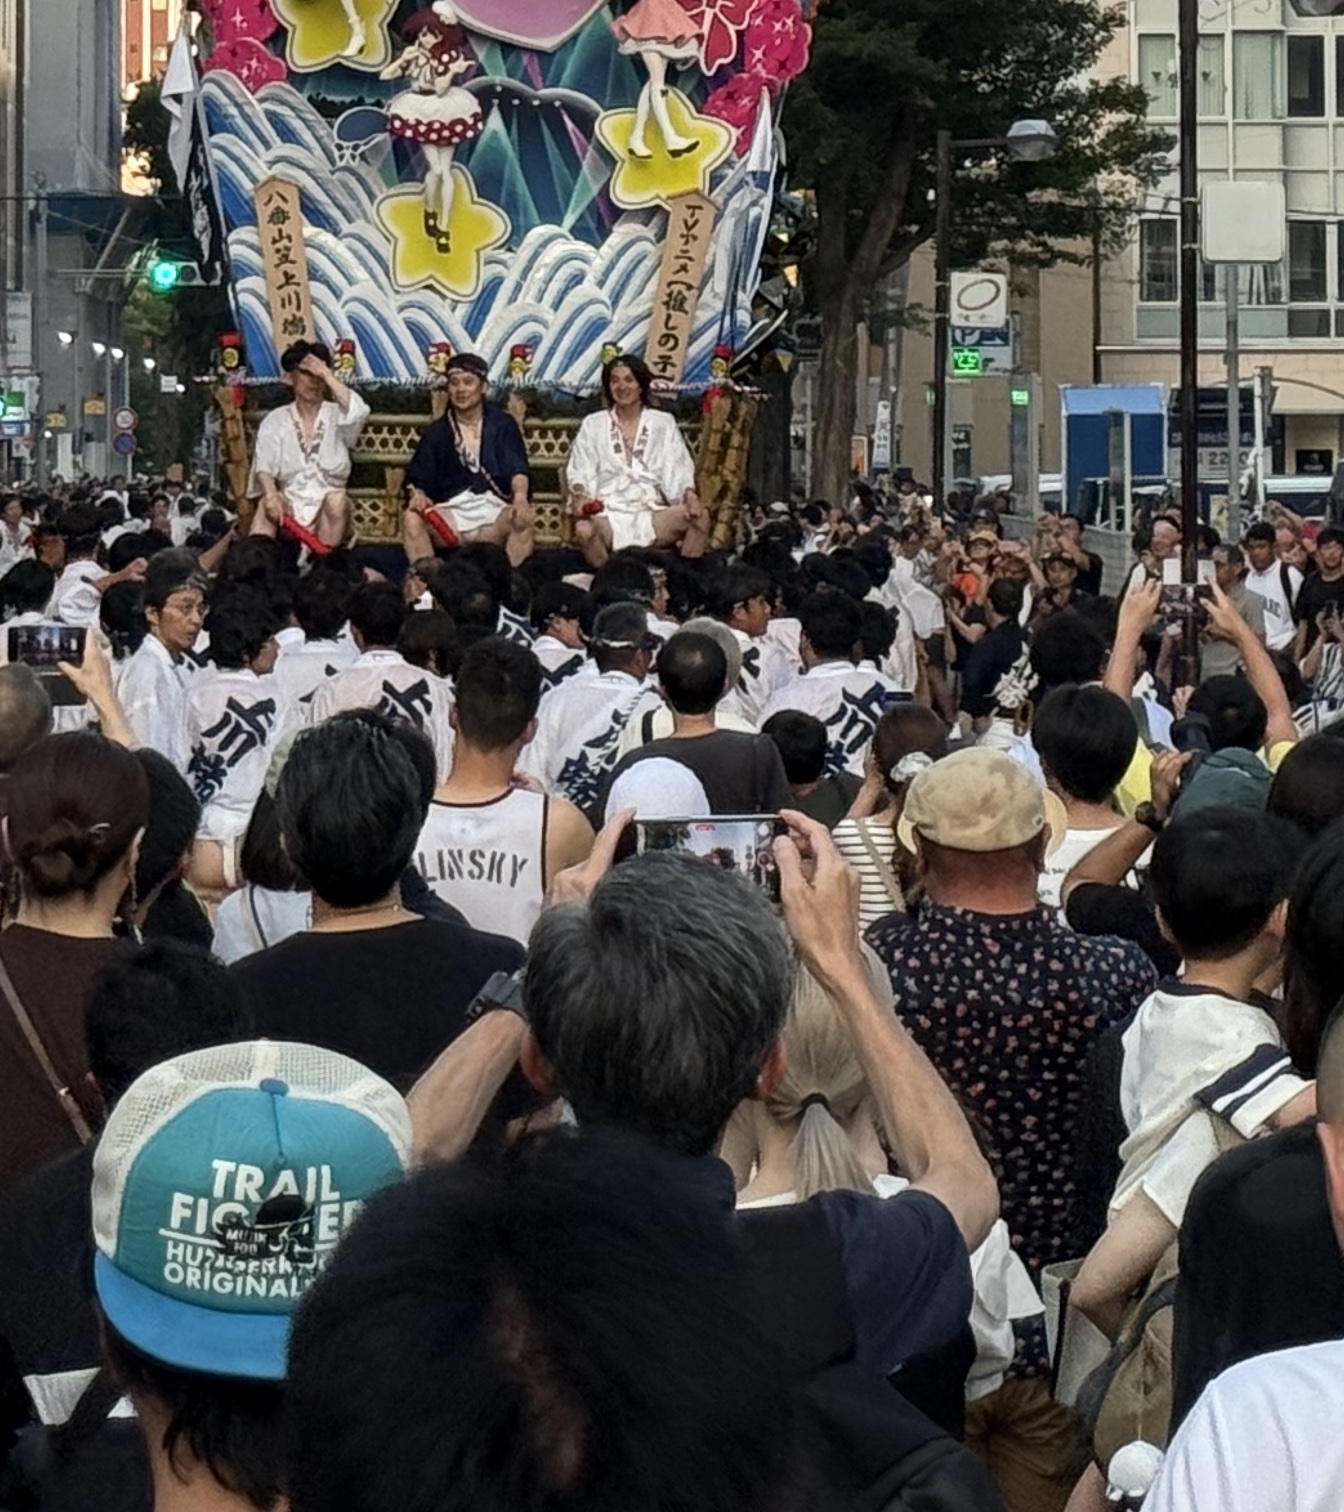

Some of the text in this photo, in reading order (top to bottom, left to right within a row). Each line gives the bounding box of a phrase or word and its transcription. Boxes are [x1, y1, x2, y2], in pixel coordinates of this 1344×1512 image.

[262, 191, 308, 348] 八番山笠上川端
[212, 1159, 340, 1203] TRAIL
